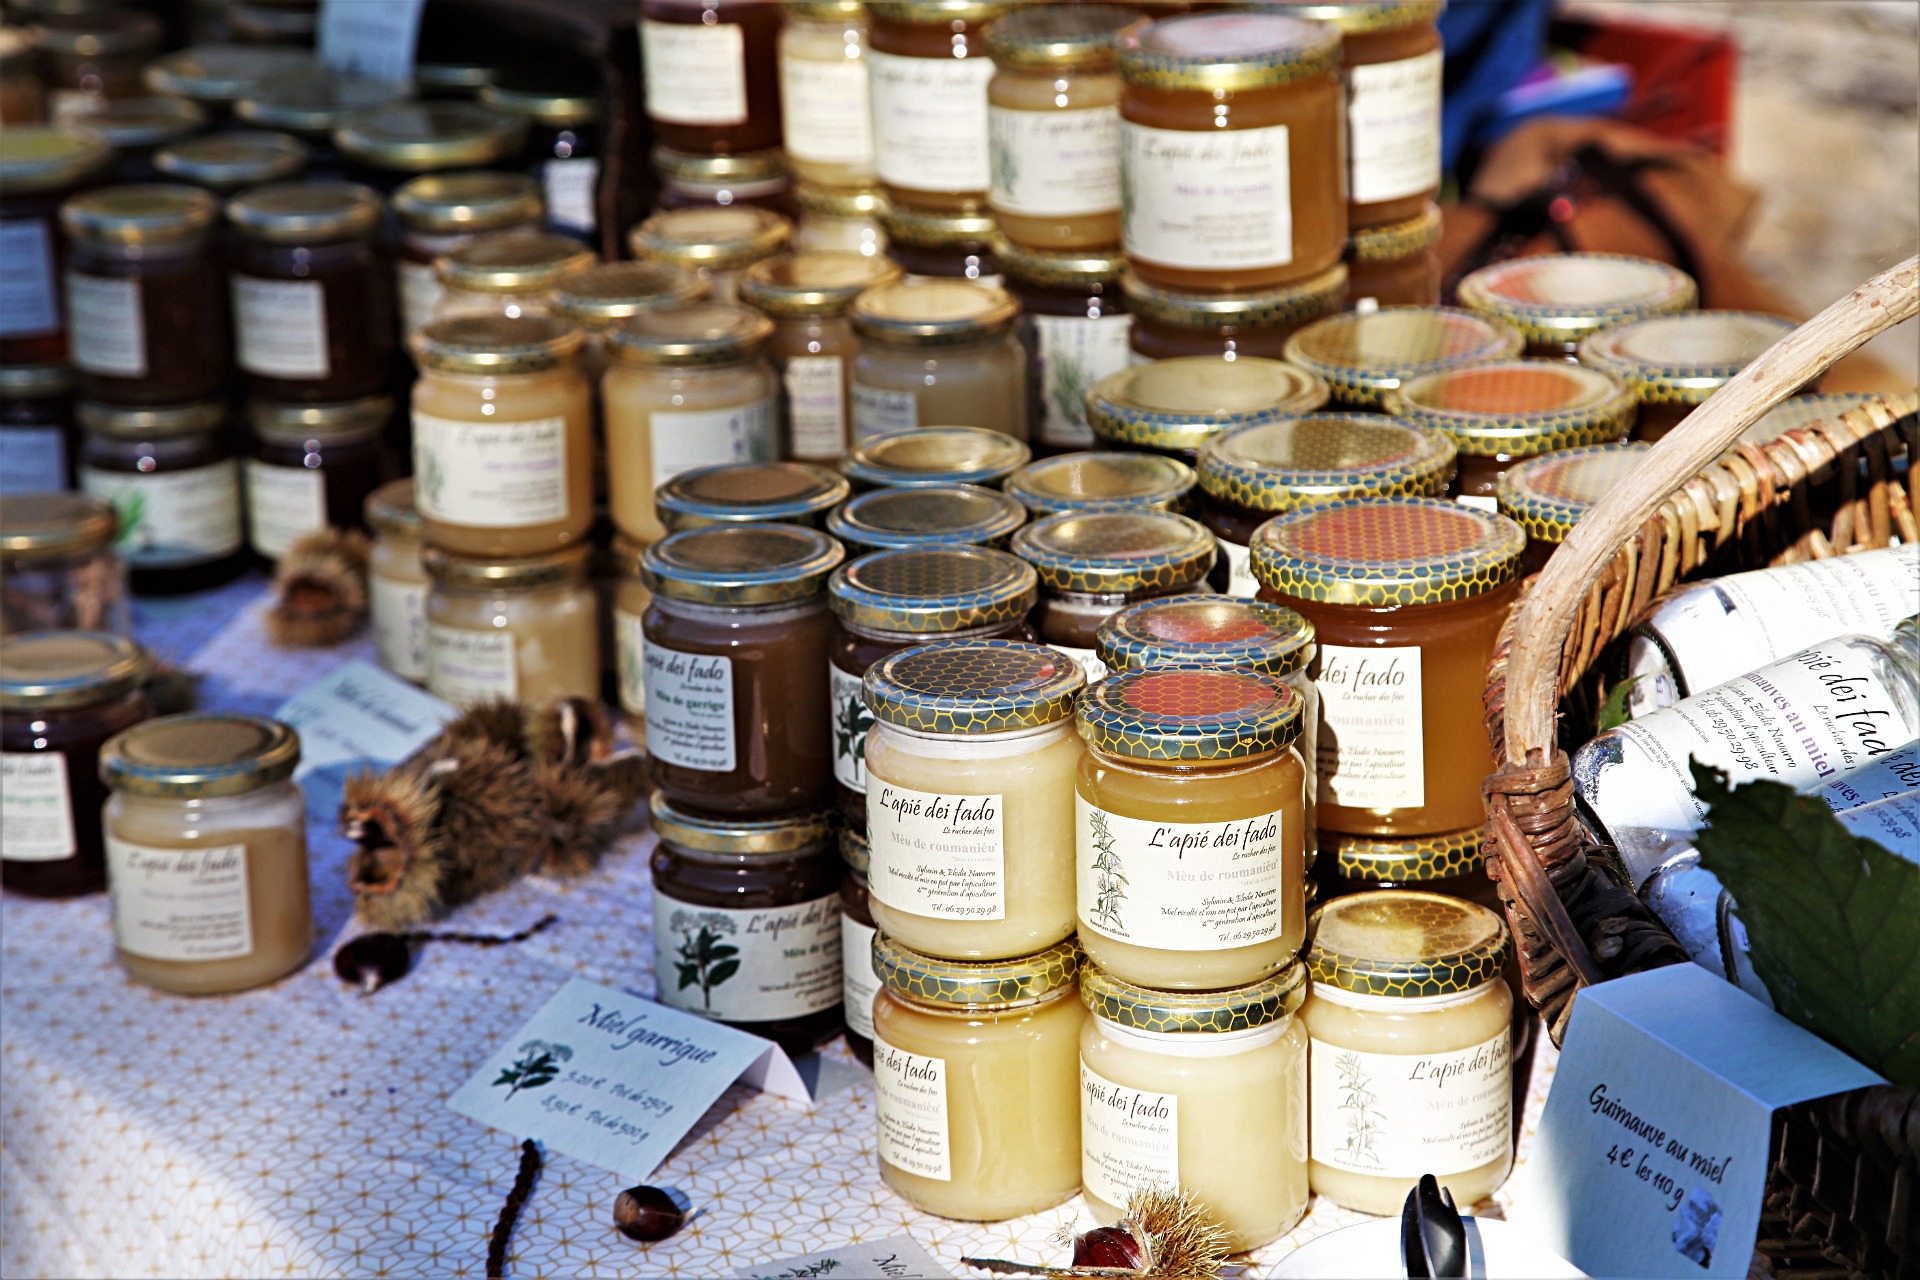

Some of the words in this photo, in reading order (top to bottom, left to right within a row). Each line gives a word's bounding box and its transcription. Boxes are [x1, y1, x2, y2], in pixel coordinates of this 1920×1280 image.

[688, 658, 724, 682] fado
[1317, 656, 1348, 684] dei
[1353, 658, 1404, 692] fado
[1819, 674, 1868, 702] dei
[1706, 710, 1760, 770] 06.29.50.29.98
[1742, 724, 1779, 774] d'apiculteur
[1750, 702, 1776, 727] Elodie
[1768, 728, 1796, 768] Navarro
[1786, 712, 1806, 732] au
[1801, 737, 1836, 778] miel
[1813, 705, 1828, 716] Le
[1822, 716, 1846, 747] rucher
[1840, 749, 1858, 764] des
[1835, 709, 1894, 756] fad
[880, 788, 922, 822] L'apié
[924, 797, 950, 820] dei
[952, 798, 994, 826] fado
[891, 832, 911, 846] Mèu
[914, 837, 926, 849] de
[943, 826, 950, 834] Le
[952, 826, 971, 834] rucher
[972, 826, 982, 834] des
[984, 826, 994, 836] fées
[1148, 828, 1210, 860] L'apié
[1213, 824, 1240, 847] dei
[1242, 814, 1276, 850] fado
[1232, 852, 1240, 860] Le
[1240, 848, 1259, 859] rucher
[938, 868, 946, 876] &
[938, 878, 948, 888] pot
[948, 881, 960, 890] par
[1168, 870, 1195, 881] Mèu
[1200, 870, 1214, 880] de
[946, 905, 997, 916] 06.29.50.29.98
[1202, 896, 1226, 909] Sylvain
[1226, 906, 1236, 918] pot
[1236, 906, 1248, 917] par
[578, 1002, 648, 1036] Miel
[610, 1027, 718, 1066] garrigue
[886, 1049, 902, 1072] dei
[904, 1056, 936, 1082] fado
[1409, 1056, 1466, 1088] L'apié
[1468, 1046, 1488, 1072] dei
[1082, 1068, 1106, 1106] L'apié
[1108, 1088, 1128, 1111] dei
[1130, 1094, 1170, 1120] fado
[1457, 1096, 1469, 1106] de
[1100, 1125, 1110, 1137] de
[1148, 1124, 1158, 1132] des
[1589, 1084, 1666, 1148] Guimauve
[1666, 1138, 1687, 1160] au
[1690, 1152, 1732, 1185] miel
[1636, 1154, 1653, 1182] les
[1653, 1172, 1674, 1196] 110
